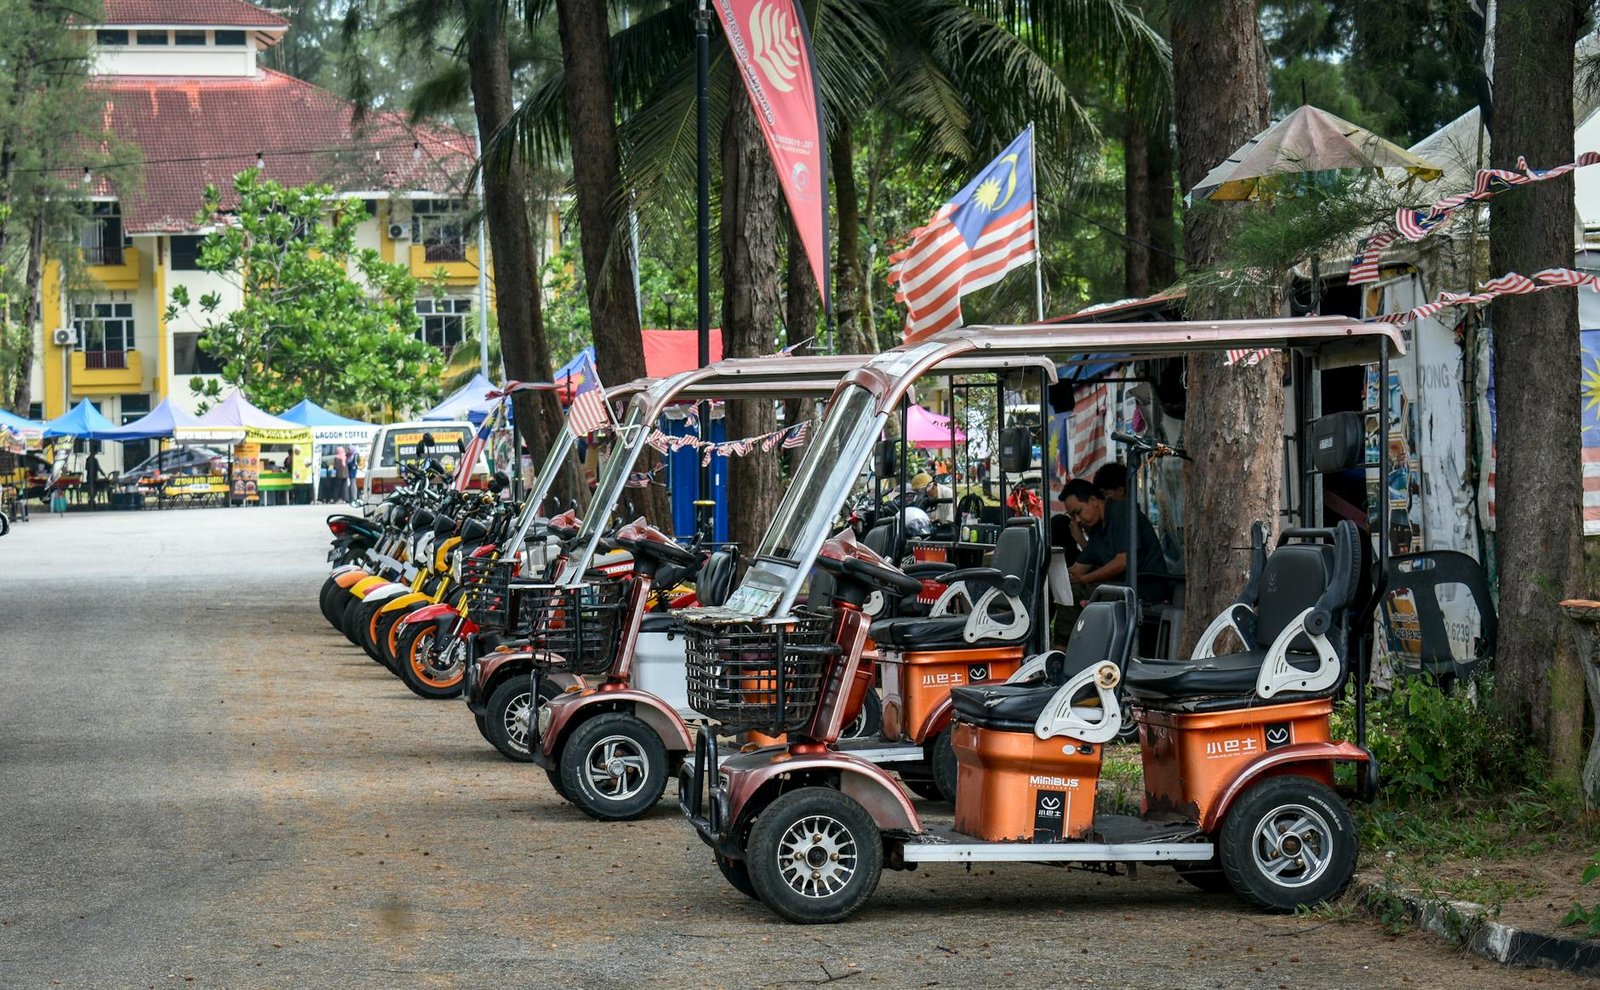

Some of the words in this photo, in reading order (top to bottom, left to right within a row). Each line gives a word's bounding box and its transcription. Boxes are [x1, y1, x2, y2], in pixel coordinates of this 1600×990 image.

[315, 431, 343, 439] LAGOON
[344, 431, 368, 439] COFFEE
[922, 672, 963, 685] 小巴士
[1206, 738, 1257, 754] 小巴士
